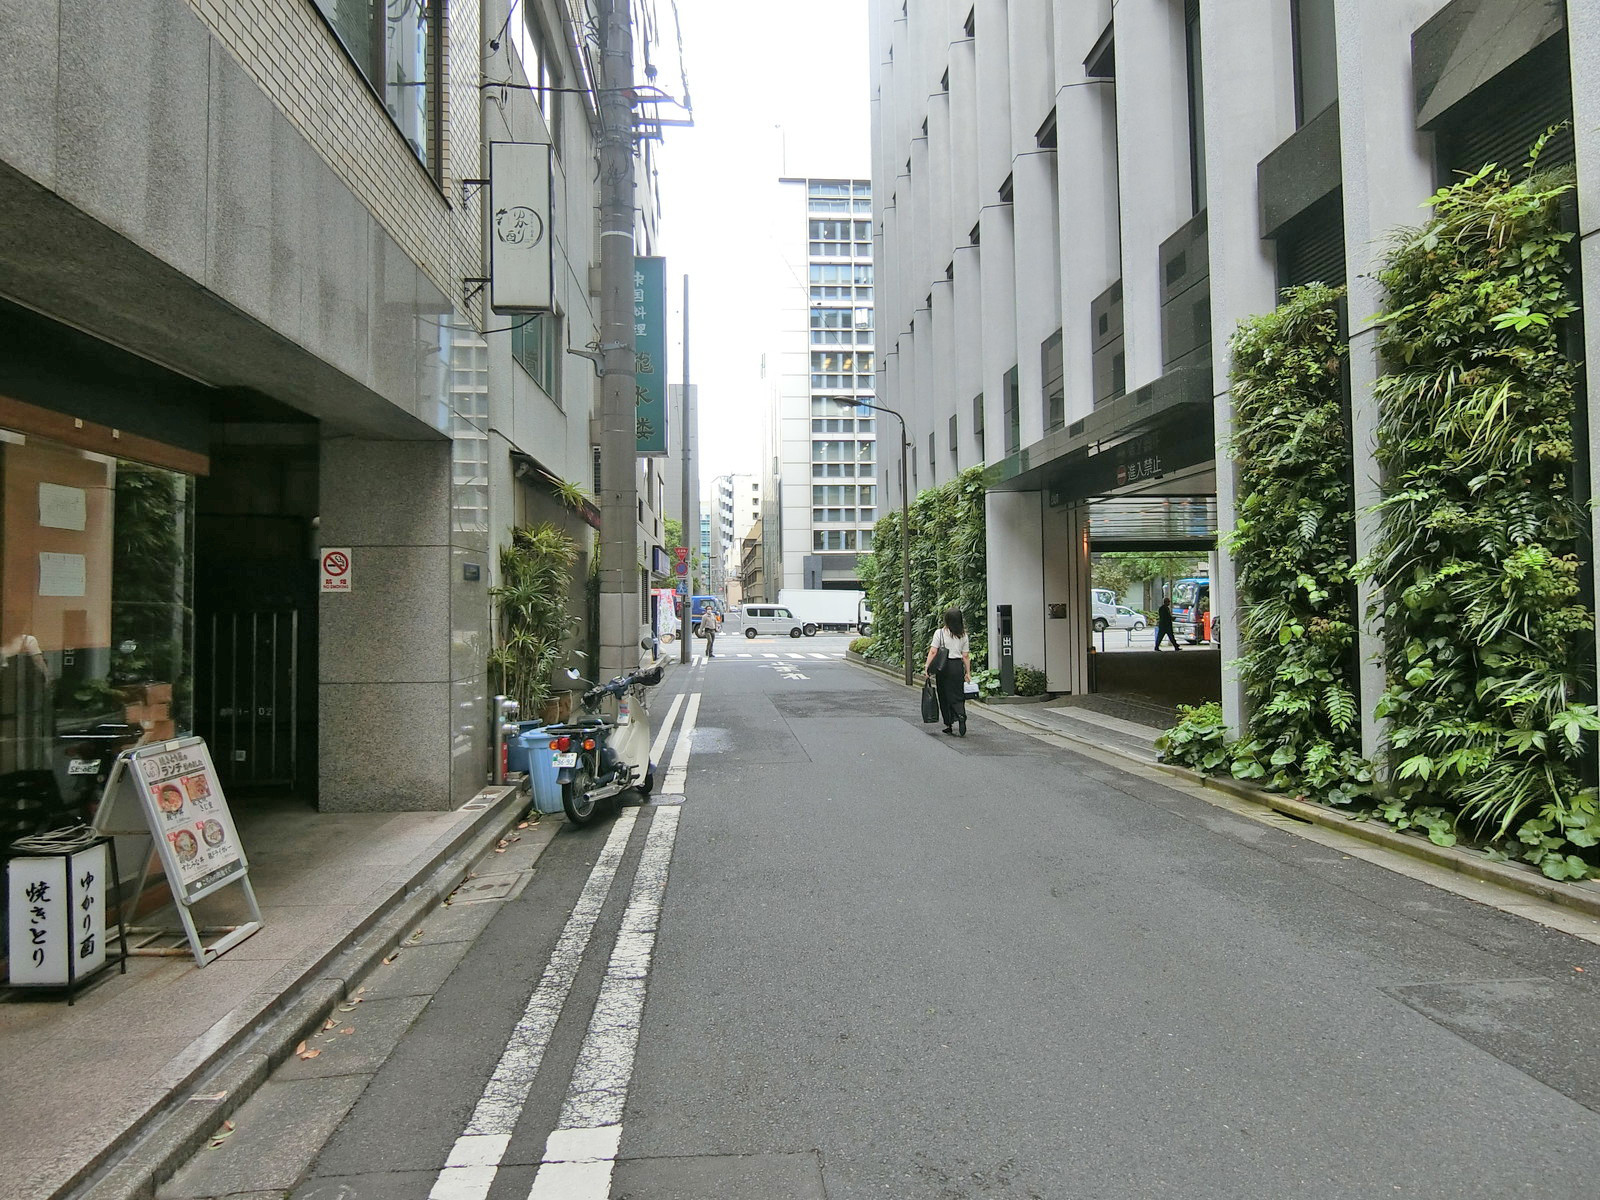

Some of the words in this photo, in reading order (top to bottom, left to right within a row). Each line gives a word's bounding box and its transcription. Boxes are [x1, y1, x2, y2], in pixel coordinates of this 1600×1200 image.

[1128, 456, 1162, 481] 進入禁止
[1003, 636, 1012, 656] 出口
[161, 762, 182, 777] ランチ
[25, 881, 51, 968] 焼きとり
